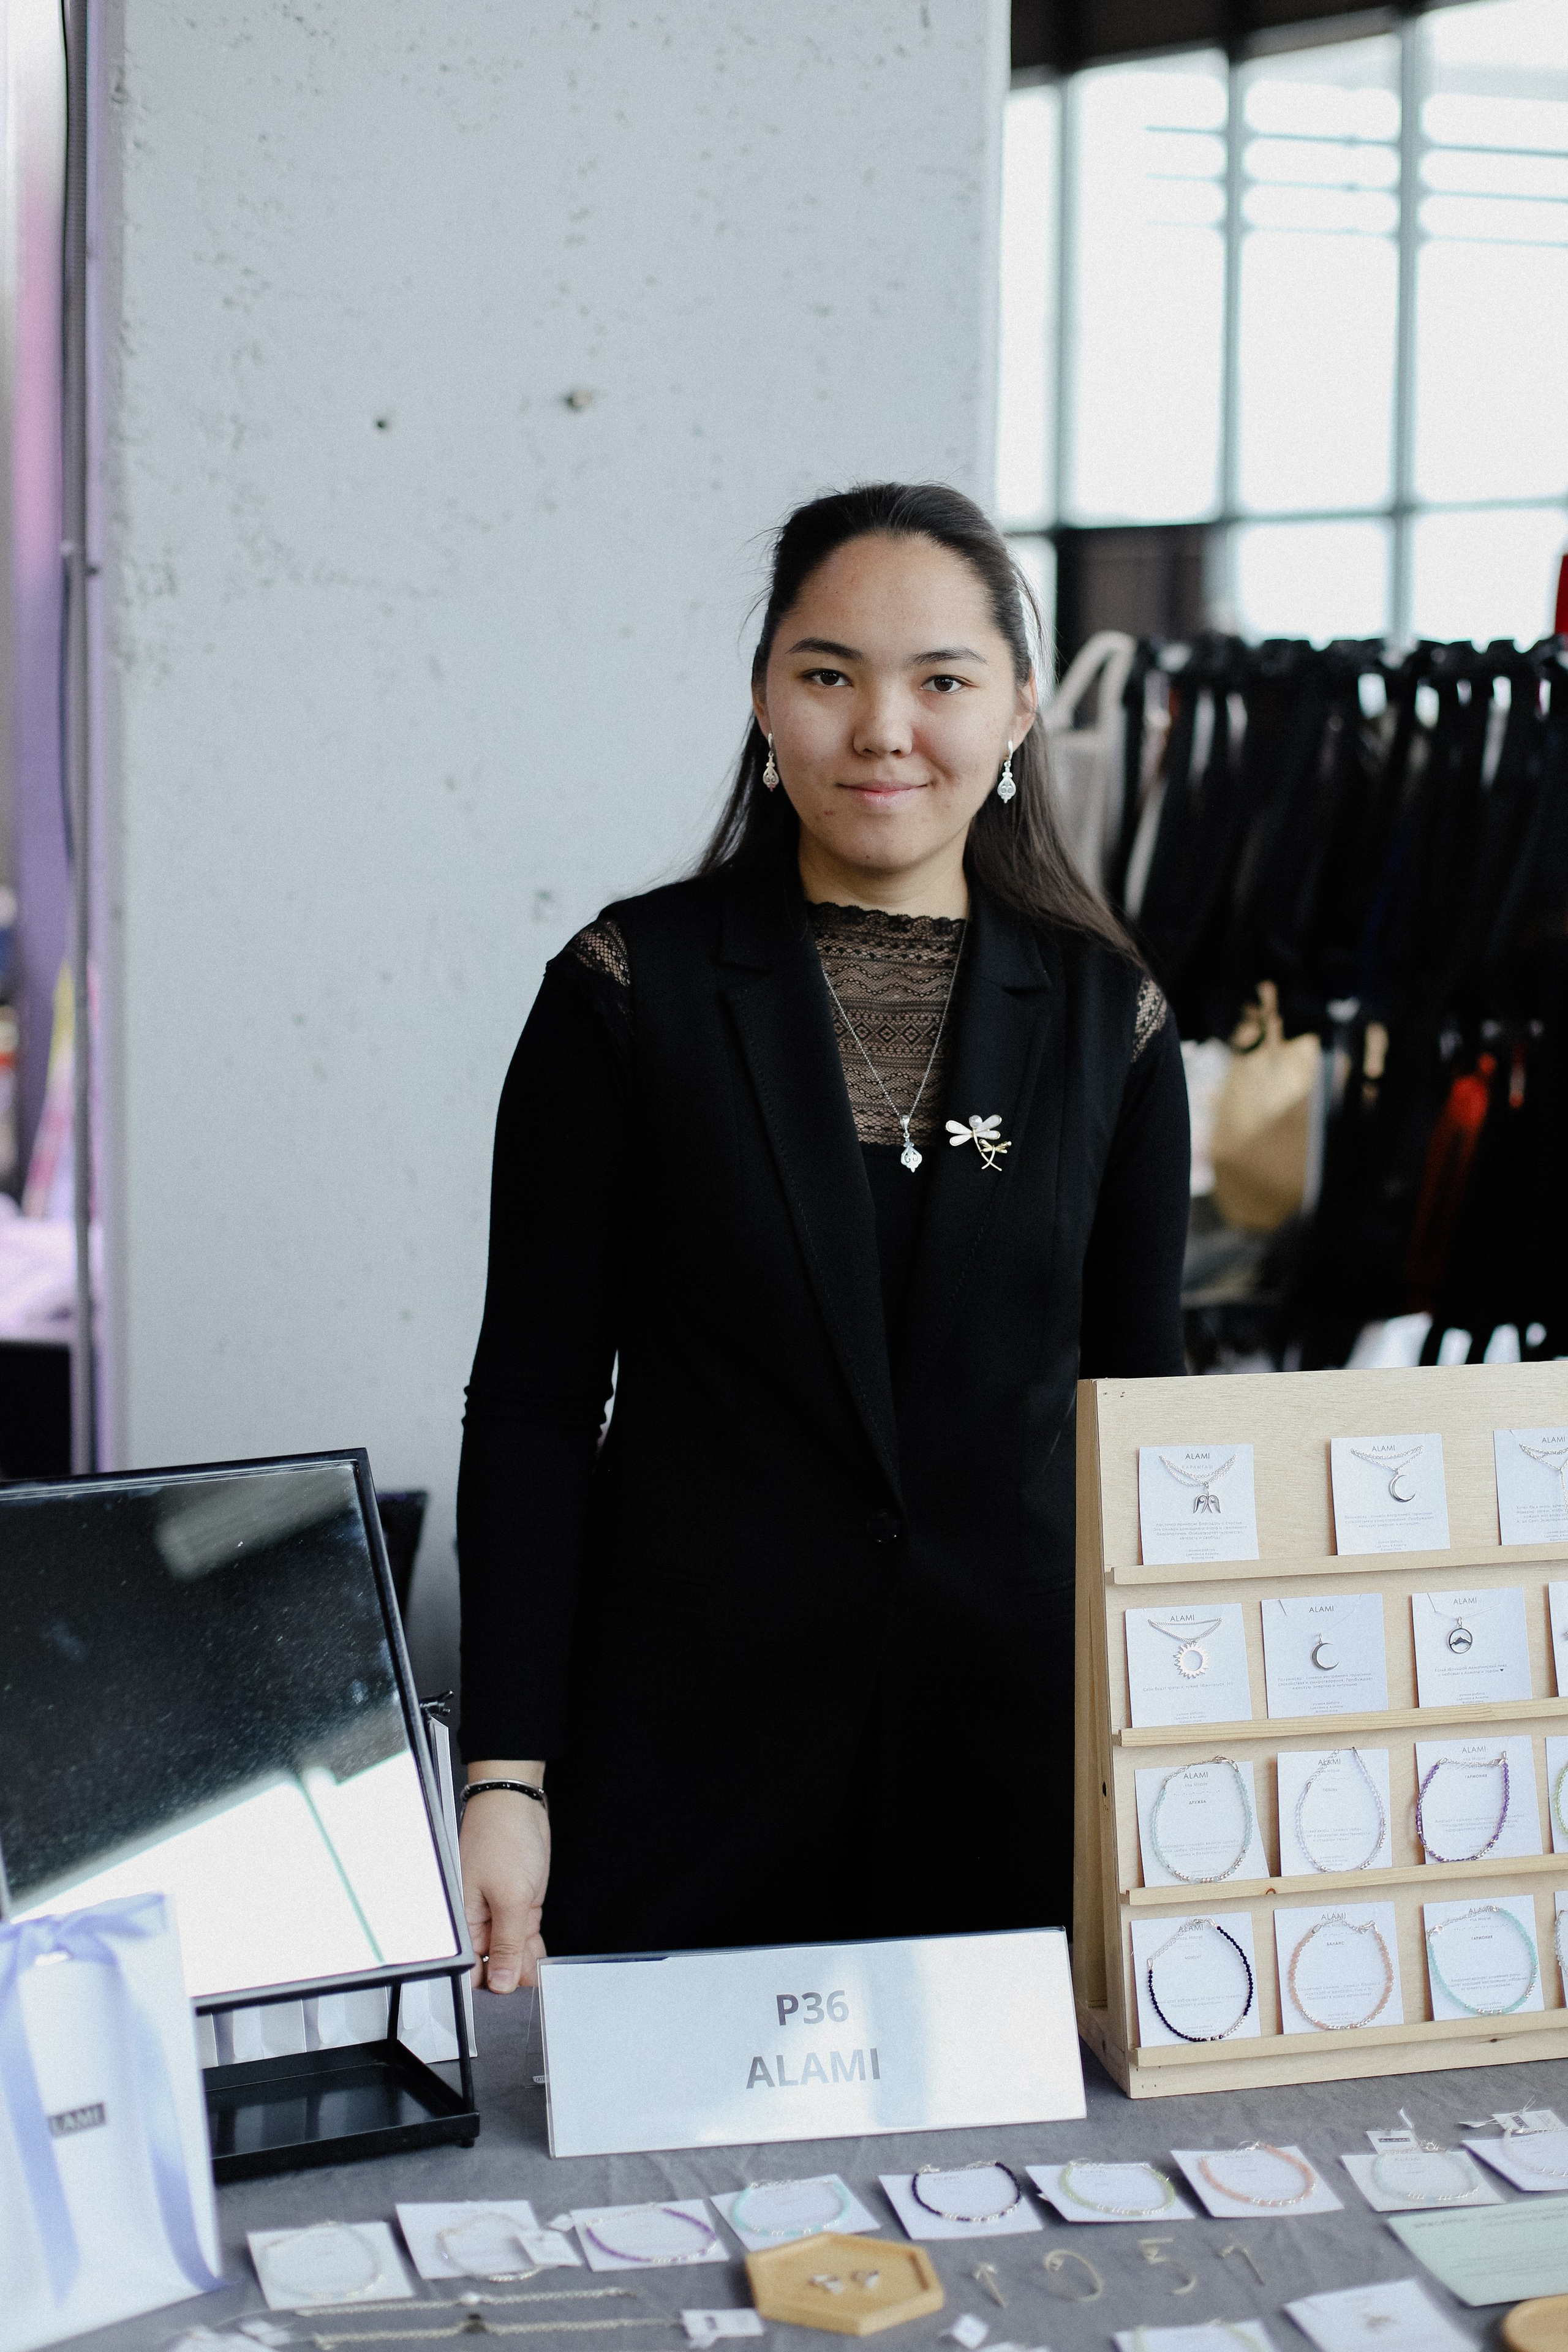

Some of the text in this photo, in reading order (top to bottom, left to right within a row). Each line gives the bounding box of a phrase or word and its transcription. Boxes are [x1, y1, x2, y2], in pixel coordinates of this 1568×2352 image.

[775, 1989, 850, 2026] P36
[745, 2048, 881, 2089] ALAMI
[50, 2105, 100, 2135] LAMI
